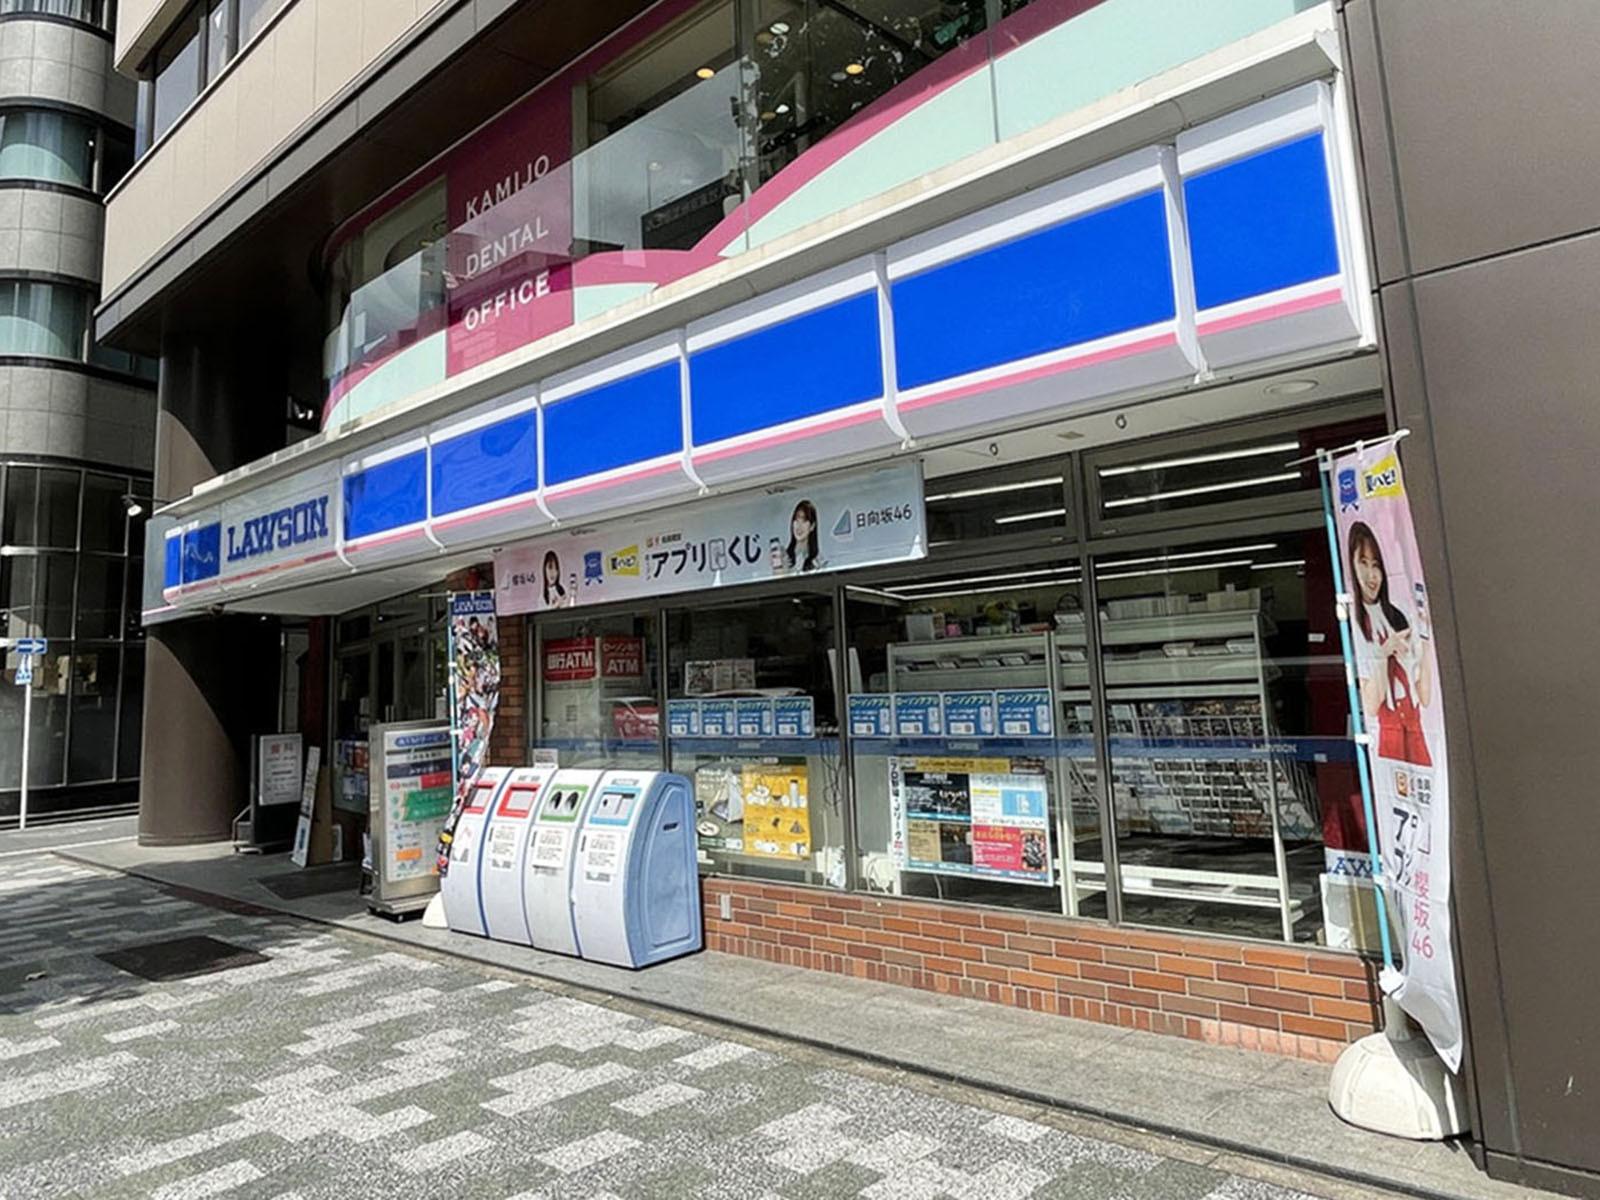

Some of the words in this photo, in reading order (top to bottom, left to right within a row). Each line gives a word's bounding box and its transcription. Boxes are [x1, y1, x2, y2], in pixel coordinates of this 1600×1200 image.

[465, 154, 550, 219] KAMIJO
[465, 217, 549, 277] DENTAL
[464, 273, 550, 331] OFFICE
[226, 495, 329, 562] LAWSON
[856, 503, 912, 529] 日向坂46
[606, 659, 640, 673] ATM
